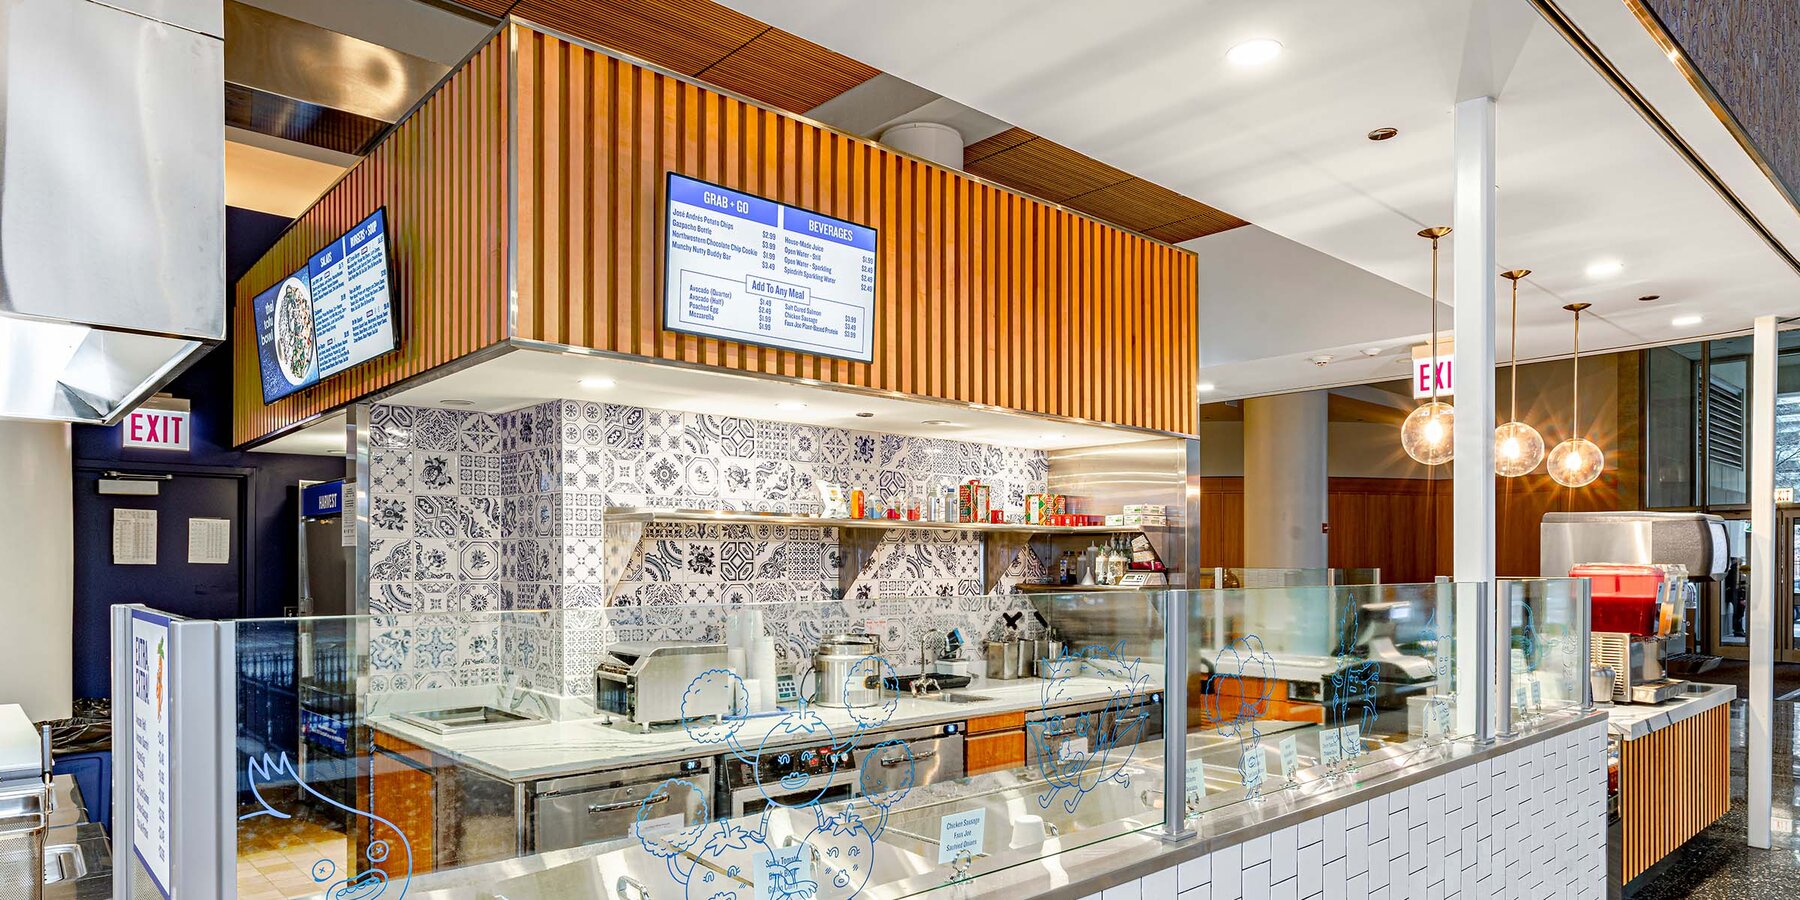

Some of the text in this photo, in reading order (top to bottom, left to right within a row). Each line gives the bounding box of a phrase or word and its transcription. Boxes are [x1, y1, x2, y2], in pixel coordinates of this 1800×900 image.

[704, 191, 728, 208] GRAB
[737, 200, 749, 214] GO
[672, 219, 712, 235] Gazpacho Bottle
[704, 216, 719, 226] Potato
[720, 220, 734, 230] Chips
[762, 231, 776, 240] $2.99
[808, 219, 853, 241] BEVERAGES
[672, 230, 758, 256] Northwestern Chocolate Chip Cookie
[762, 241, 776, 250] $3.99
[812, 243, 824, 252] Juice
[672, 241, 731, 260] Munchy Nutty Buddy Bar
[762, 251, 775, 260] $1.99
[784, 247, 796, 255] Open
[797, 249, 809, 258] Water
[762, 261, 775, 270] $3.49
[784, 257, 795, 266] Open
[796, 259, 809, 268] Water
[812, 263, 832, 275] Sparkling
[804, 271, 823, 282] Sparkling
[824, 276, 836, 284] Water
[690, 284, 709, 294] Avocado
[752, 280, 805, 300] Add To Any Meal
[689, 293, 709, 303] Avocado
[689, 302, 719, 315] Poached Egg
[784, 303, 821, 316] Salt Cured Salmon
[689, 310, 714, 321] Mozzarella
[784, 312, 818, 324] Chicken Sausage
[261, 329, 274, 346] bowl
[1420, 361, 1451, 391] EXI
[131, 413, 183, 444] EXIT
[946, 818, 980, 830] Chicken Sausage
